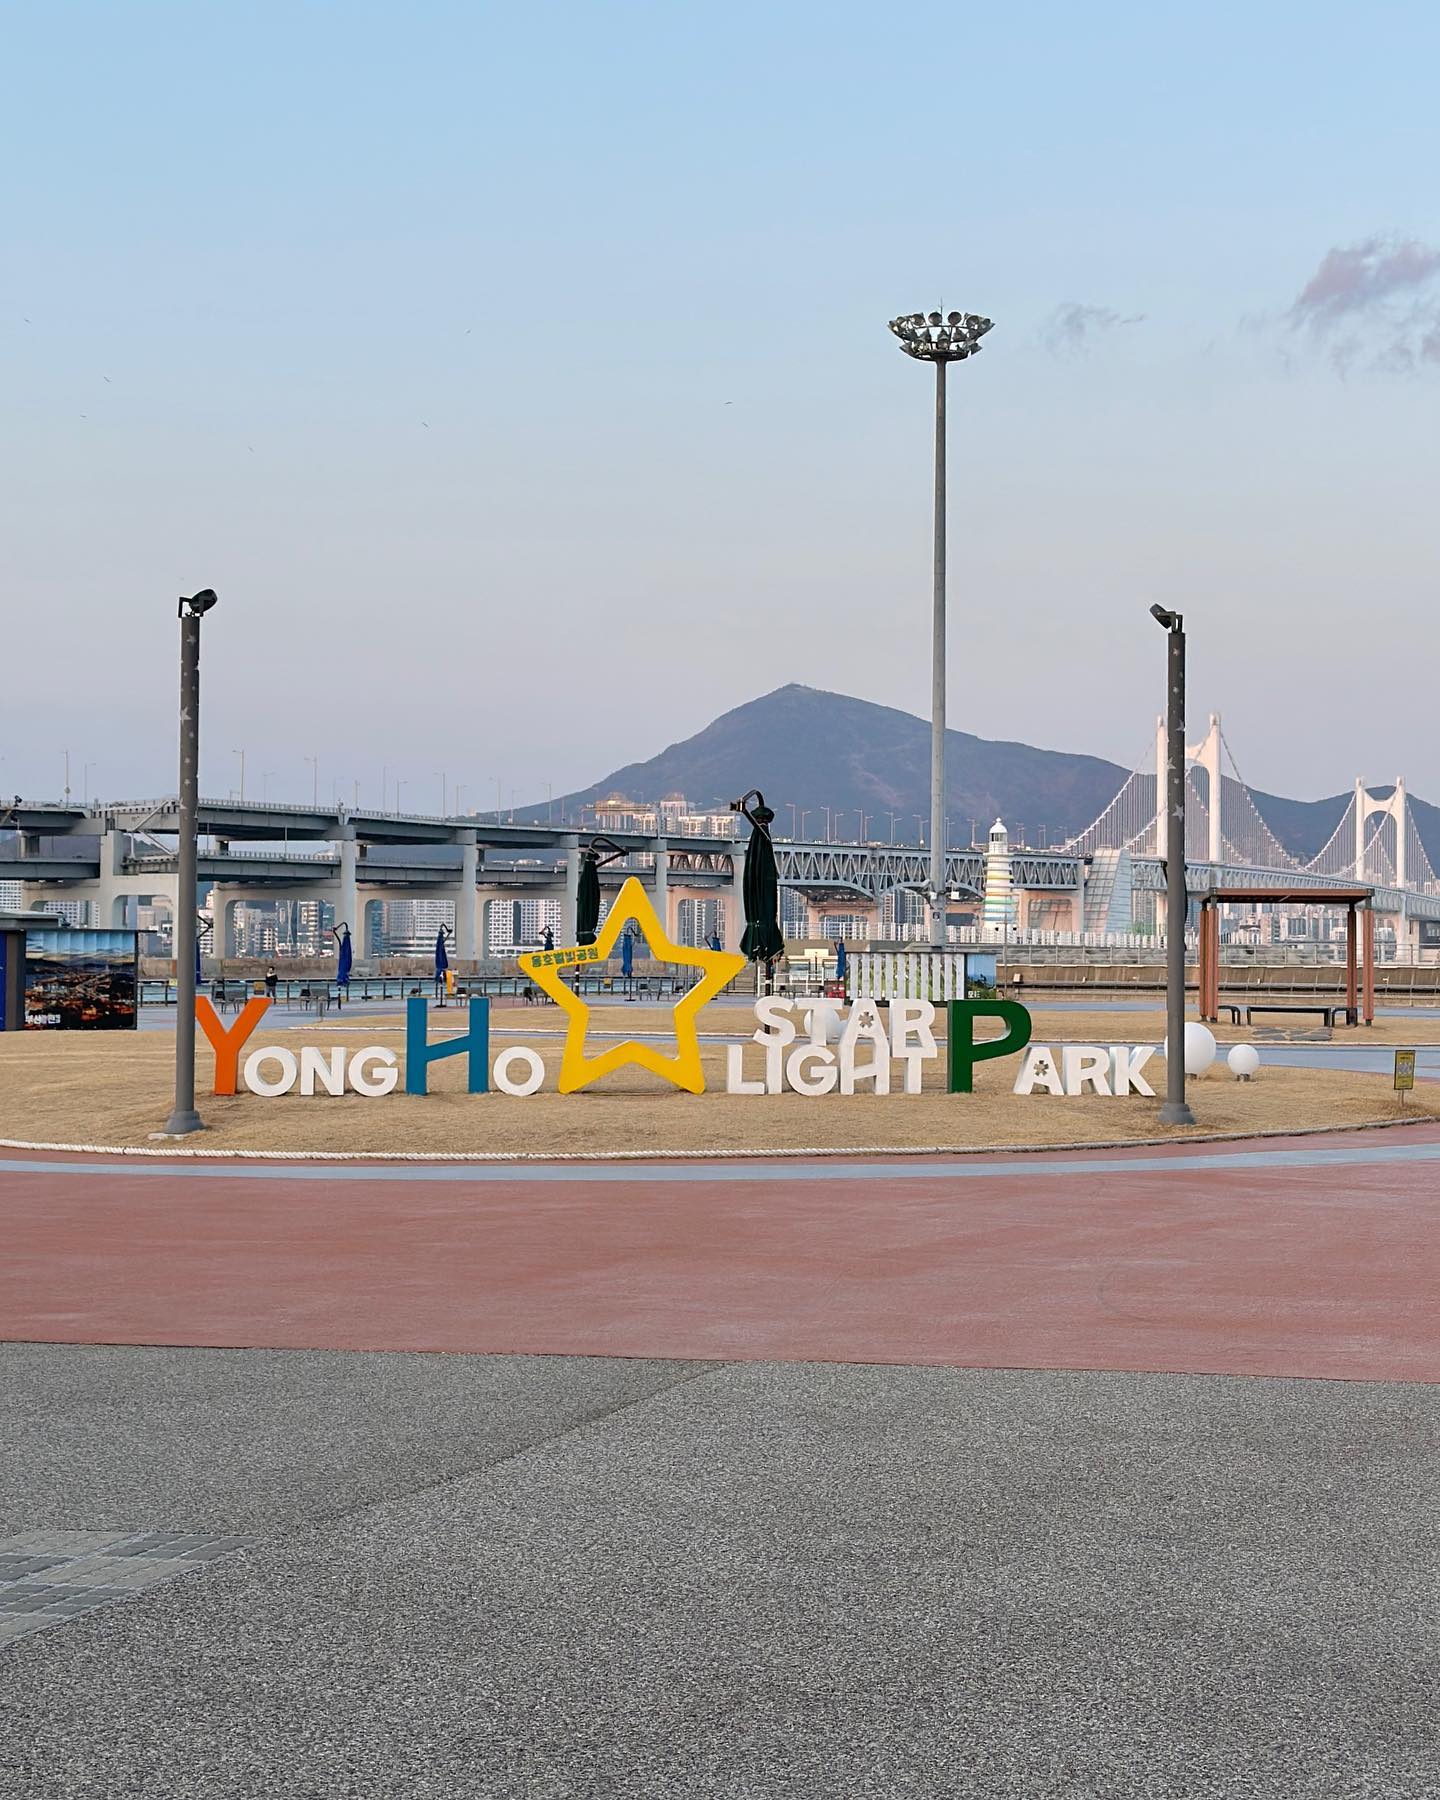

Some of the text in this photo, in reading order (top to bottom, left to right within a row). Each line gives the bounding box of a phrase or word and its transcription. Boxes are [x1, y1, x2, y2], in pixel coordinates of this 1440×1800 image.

[753, 995, 936, 1048] STAR
[947, 999, 1157, 1097] PARK
[727, 1044, 938, 1097] LIGHT
